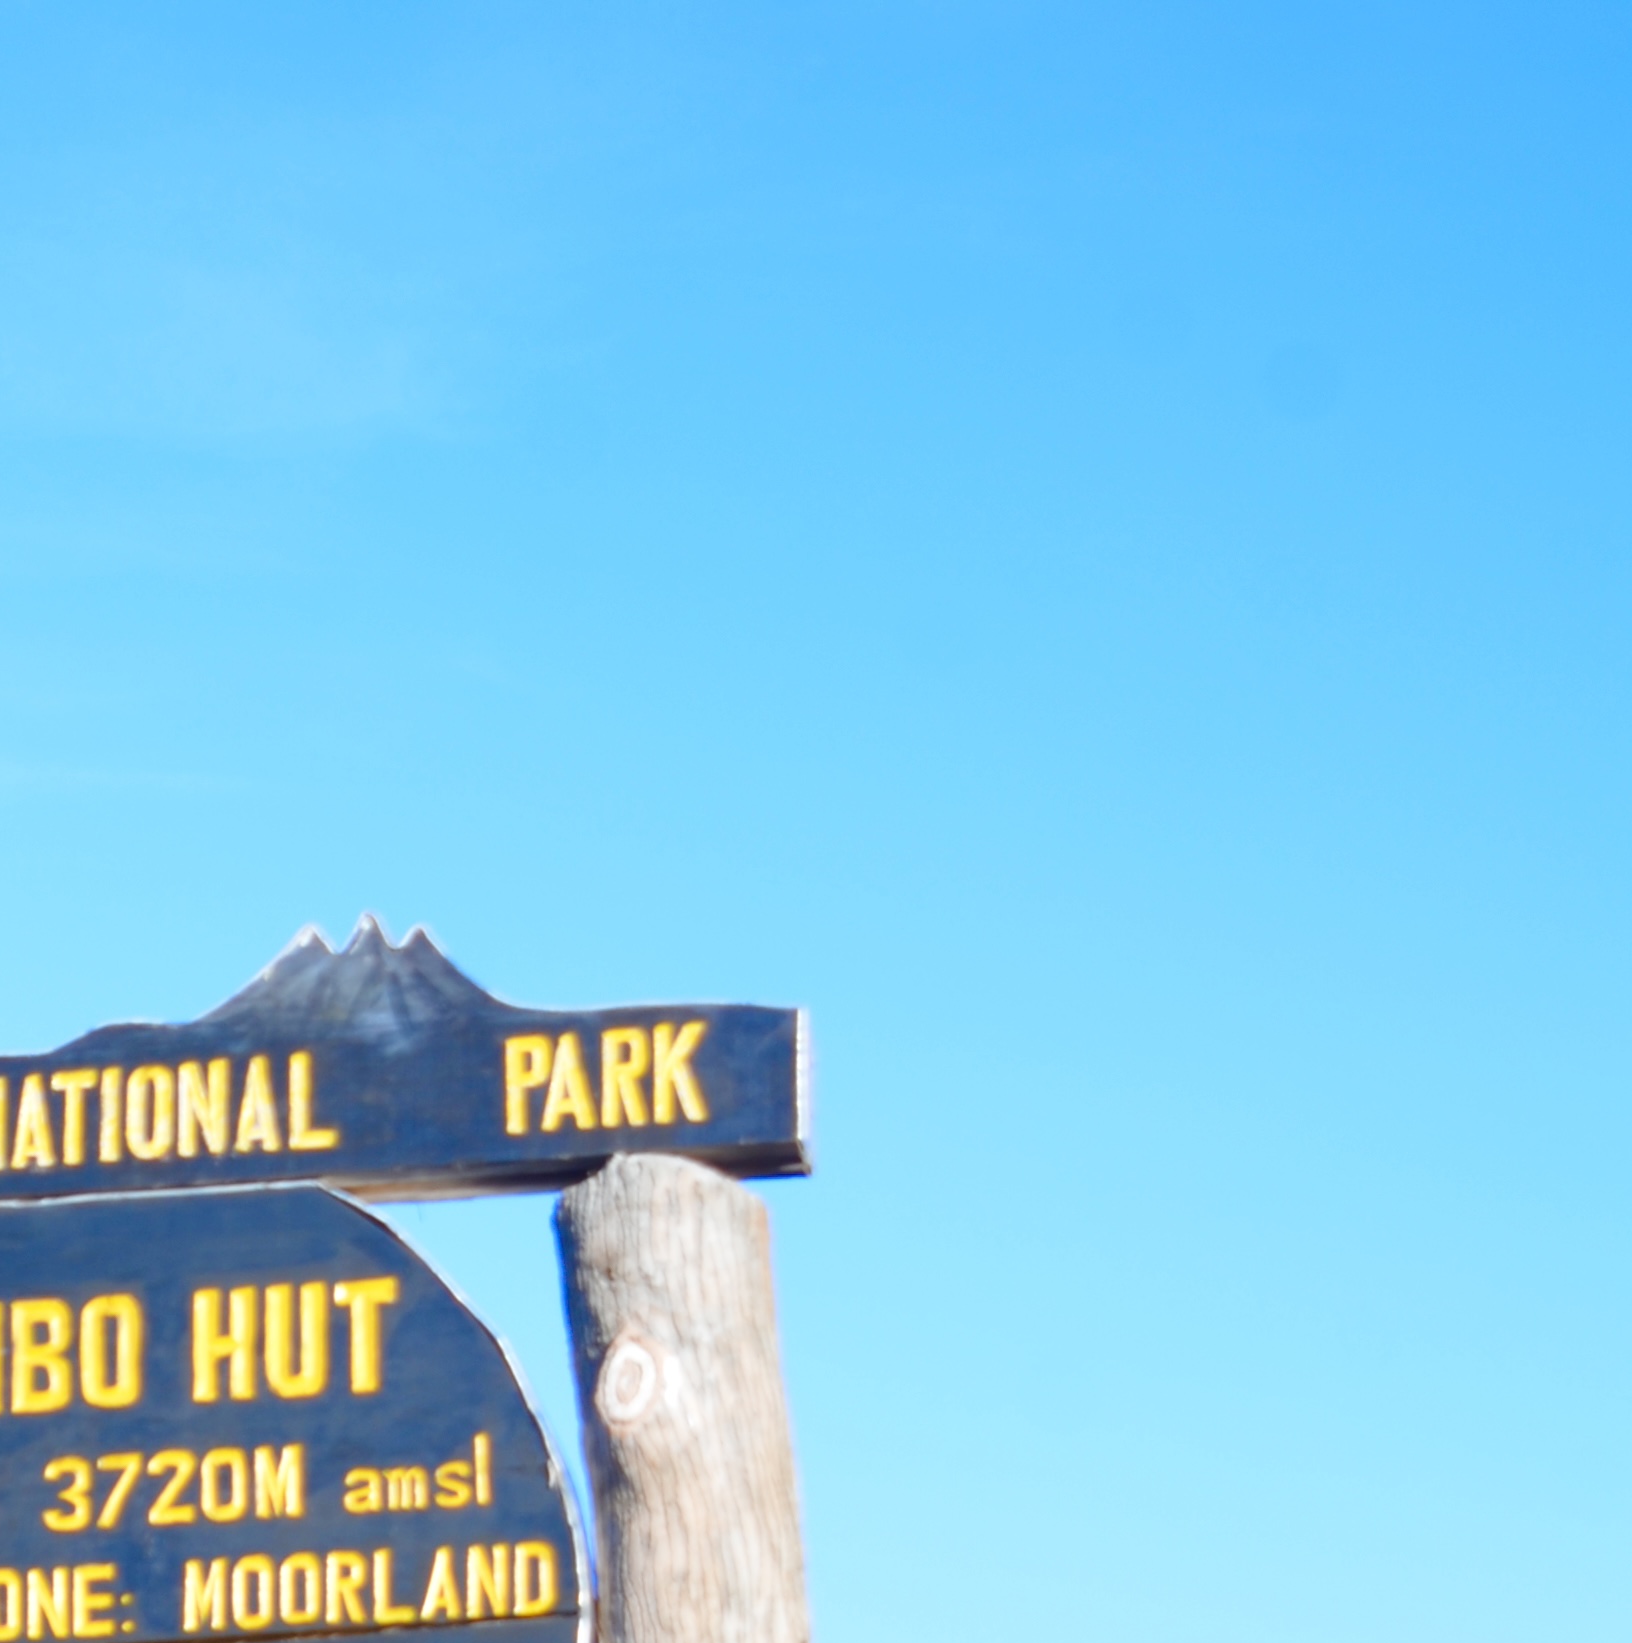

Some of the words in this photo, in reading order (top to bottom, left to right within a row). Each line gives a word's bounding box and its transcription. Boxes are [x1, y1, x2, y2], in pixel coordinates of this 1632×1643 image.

[502, 1019, 709, 1137] PARK
[190, 1275, 401, 1406] HUT
[41, 1442, 307, 1534] 3720M
[342, 1431, 493, 1516] amsl
[181, 1539, 561, 1636] MOORLAND
